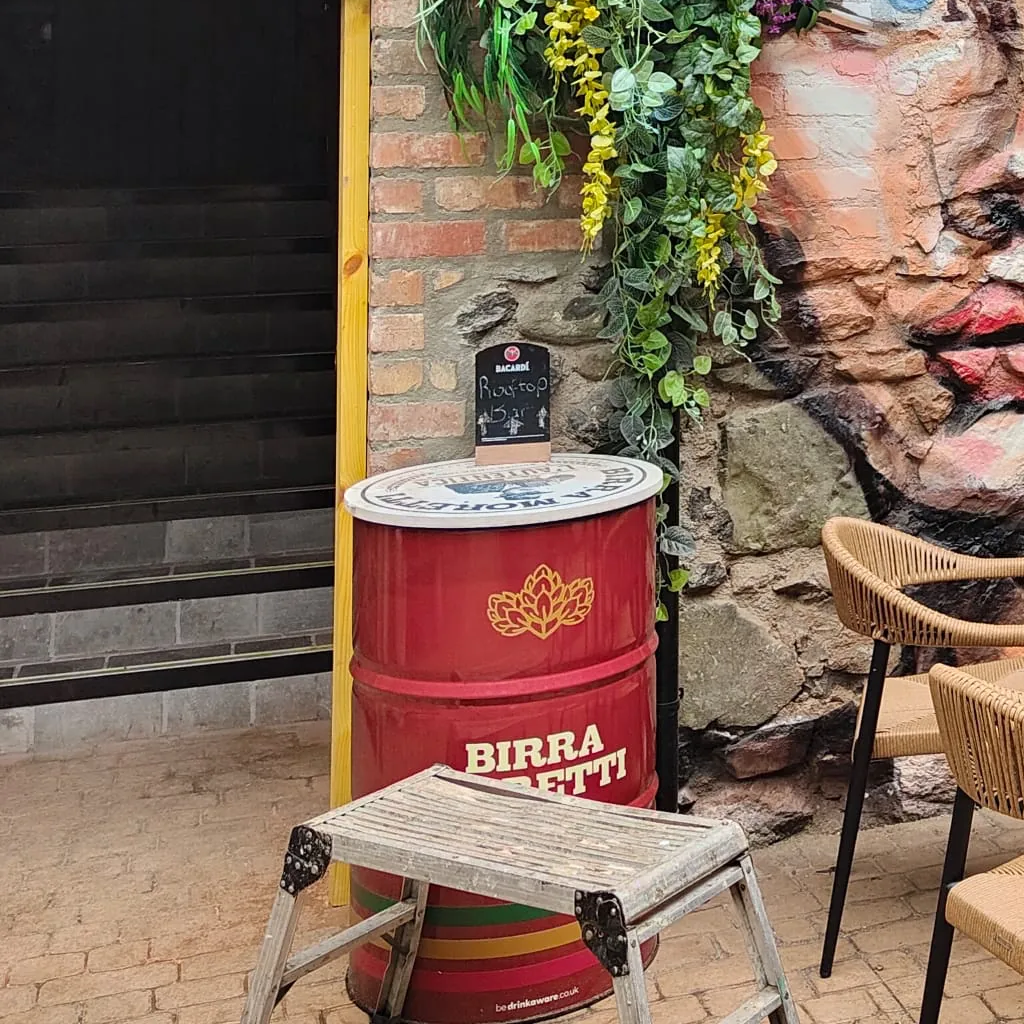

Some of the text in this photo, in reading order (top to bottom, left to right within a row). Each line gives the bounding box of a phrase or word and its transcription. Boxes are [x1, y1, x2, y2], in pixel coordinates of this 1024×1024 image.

[560, 467, 634, 501] BIRRA
[373, 492, 559, 512] MORETTI
[465, 724, 604, 774] BIRRA
